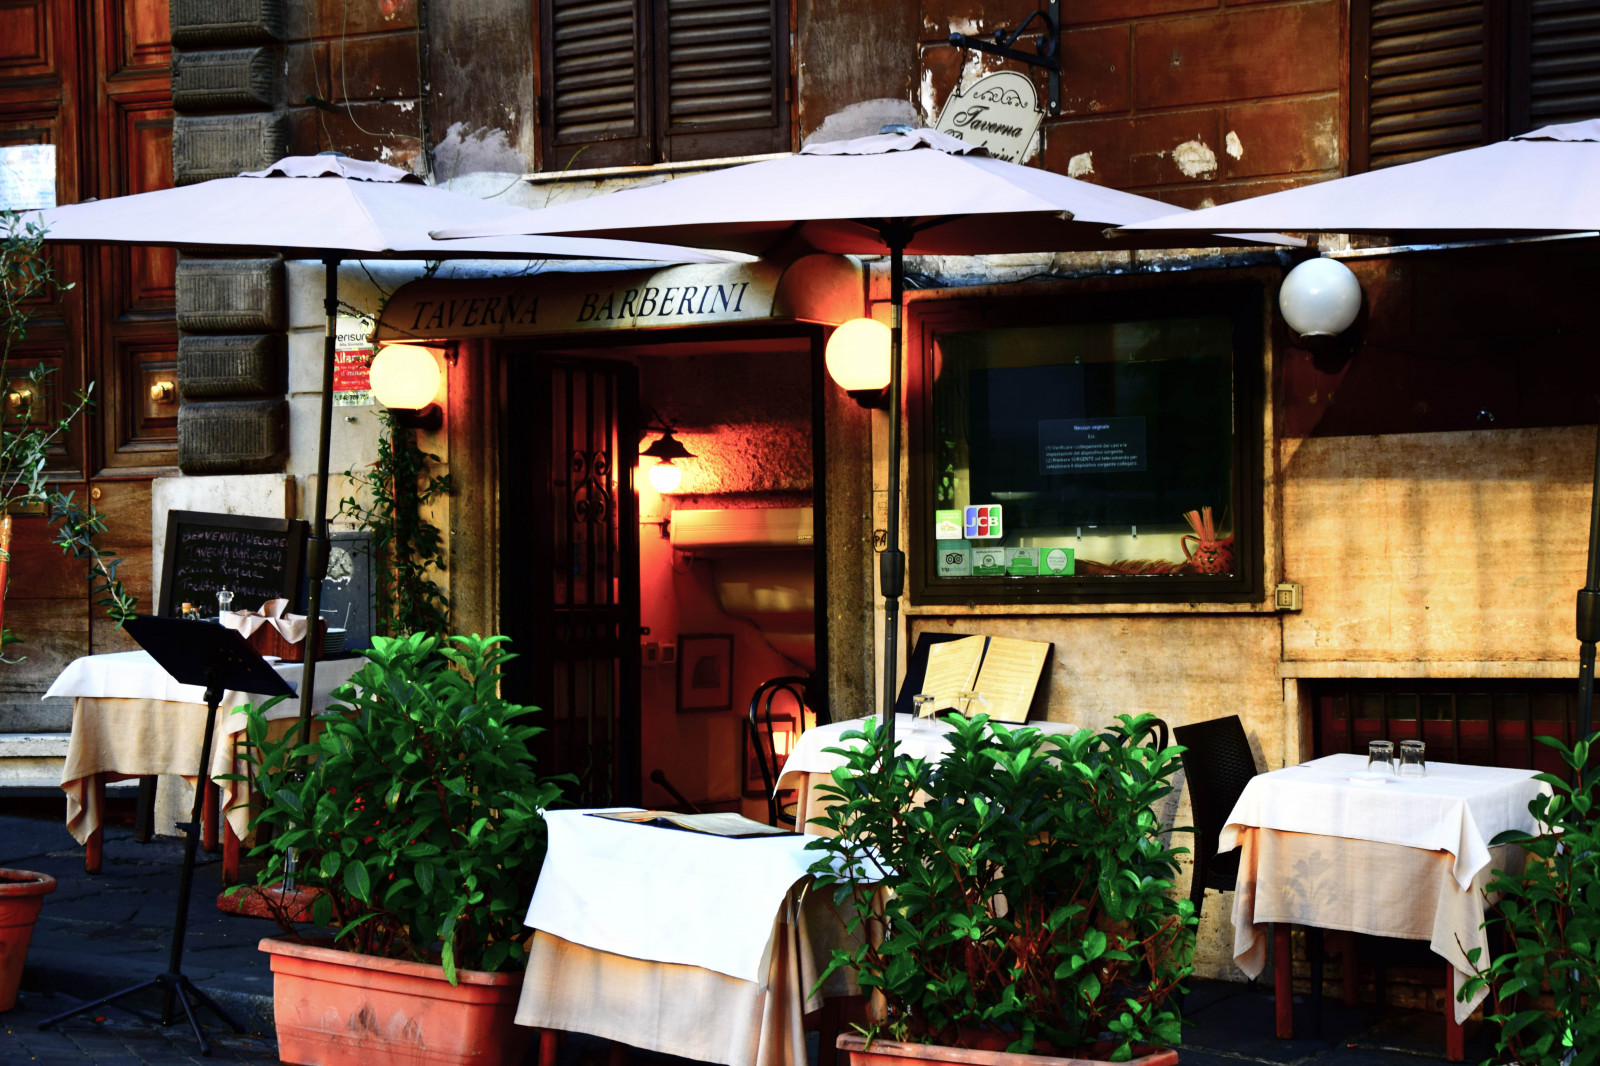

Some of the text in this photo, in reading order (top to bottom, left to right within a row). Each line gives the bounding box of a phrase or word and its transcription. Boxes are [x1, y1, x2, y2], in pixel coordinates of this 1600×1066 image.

[953, 105, 1023, 138] Taverna
[410, 281, 750, 330] TAVERNA BARBERINI
[965, 516, 999, 527] JCB
